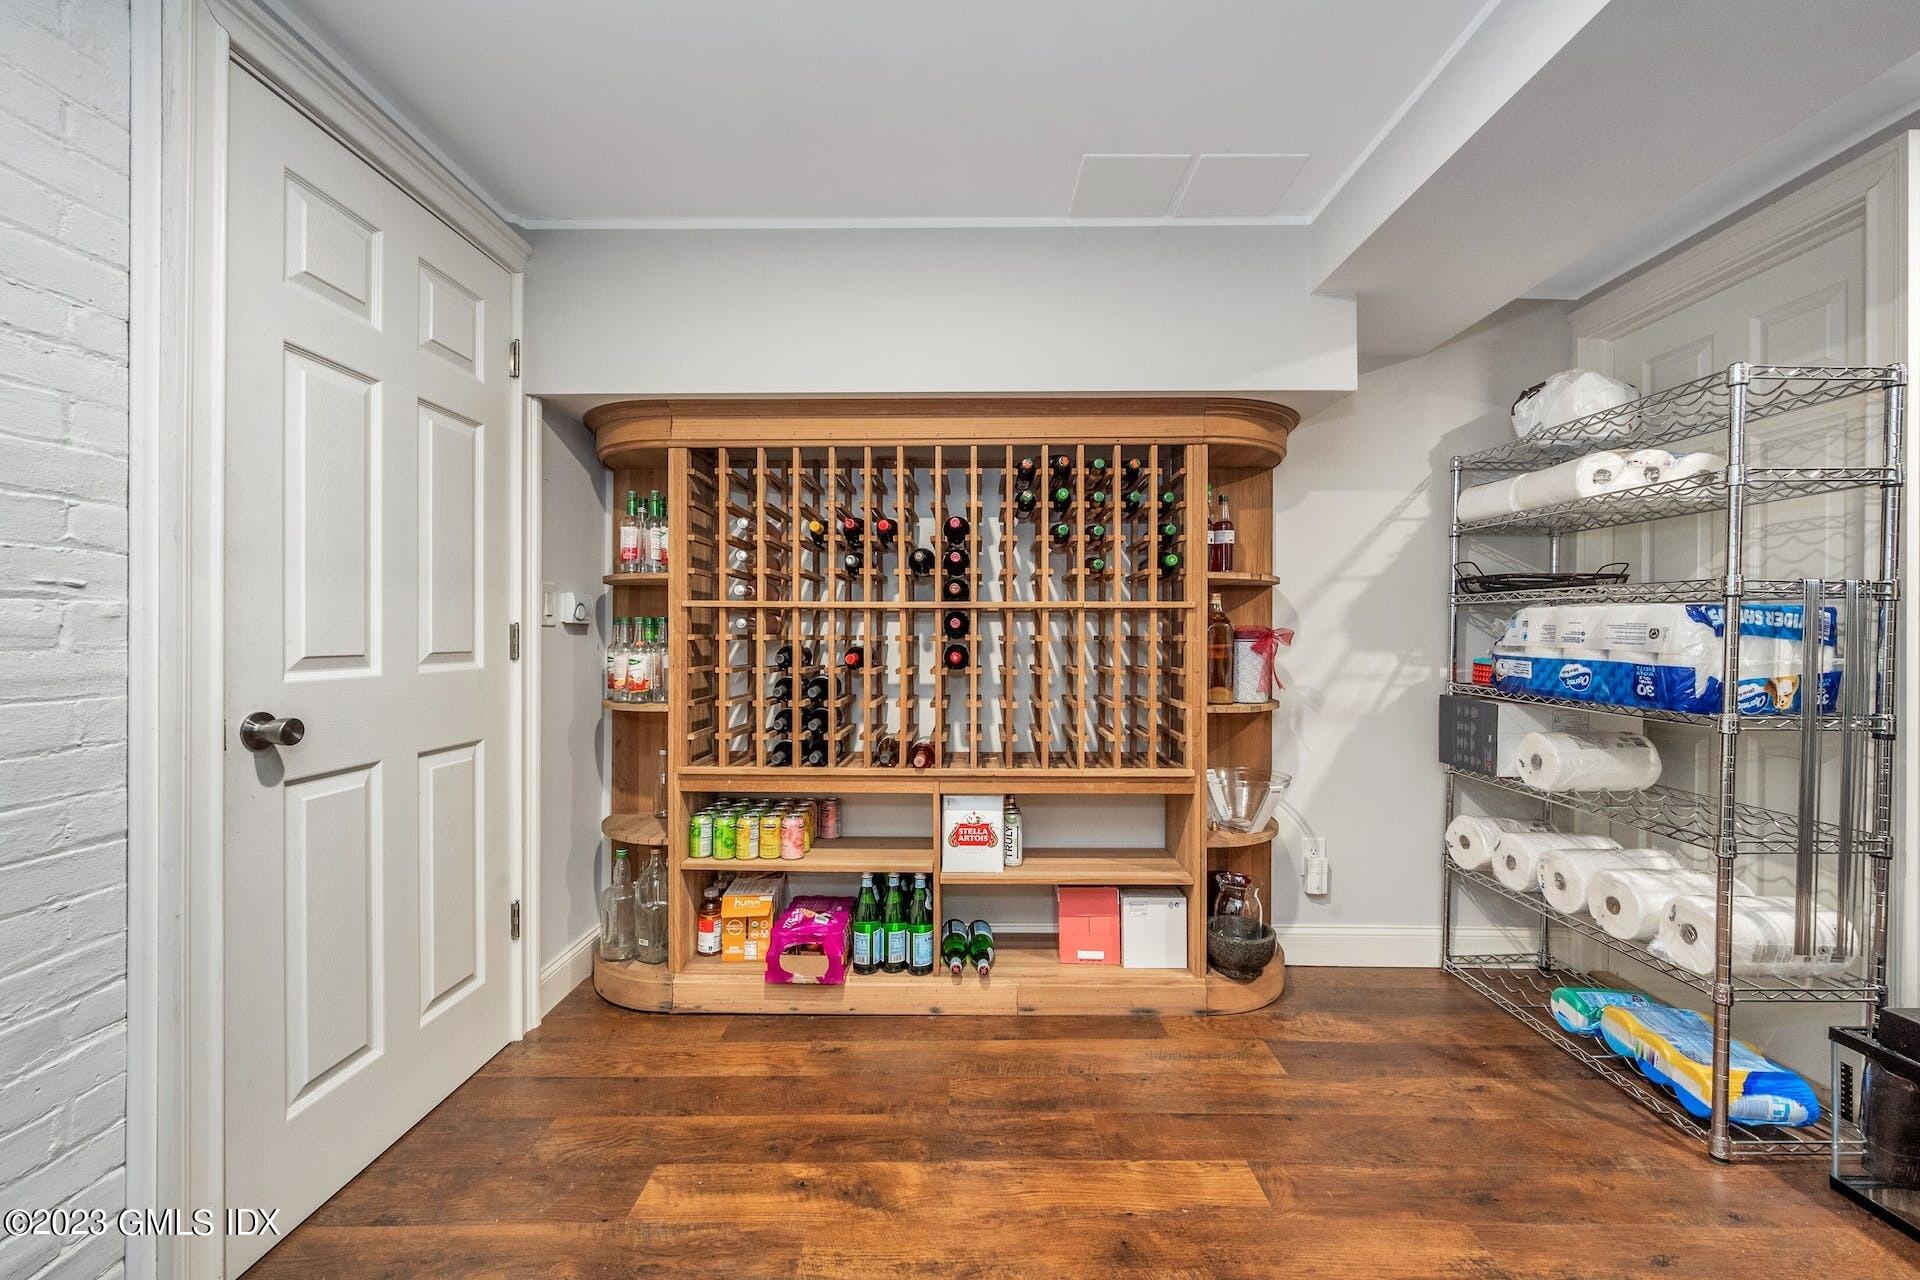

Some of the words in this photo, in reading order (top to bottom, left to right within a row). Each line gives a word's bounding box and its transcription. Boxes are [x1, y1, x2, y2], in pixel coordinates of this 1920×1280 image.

[1636, 684, 1655, 697] 30
[958, 827, 988, 835] STELLA
[957, 834, 989, 842] ARTOIS
[1004, 825, 1013, 858] TRULY
[734, 897, 760, 907] humm
